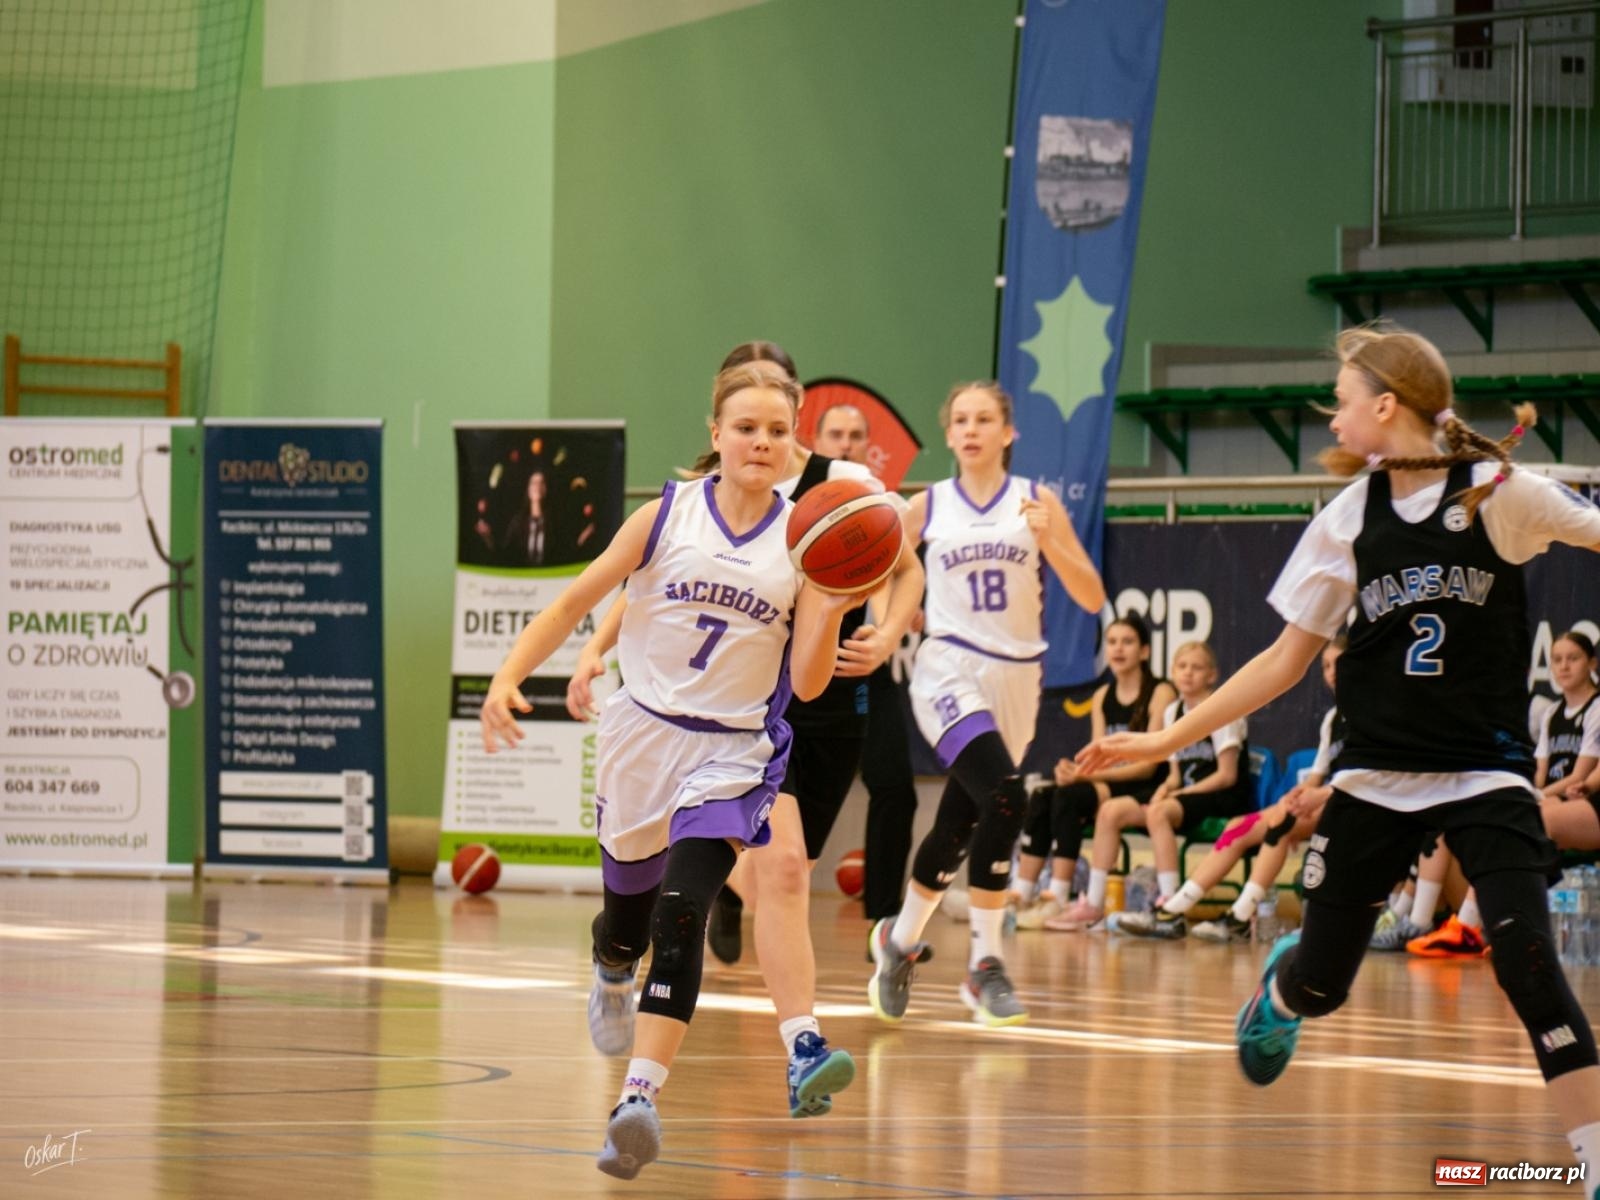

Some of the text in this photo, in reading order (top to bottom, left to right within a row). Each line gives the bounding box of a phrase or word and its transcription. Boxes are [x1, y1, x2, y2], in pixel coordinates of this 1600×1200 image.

[9, 443, 124, 466] ostromed
[9, 468, 122, 481] CENTRUM MEDYCZNE
[307, 461, 369, 483] STUDIO
[9, 522, 93, 534] DIAGNOSTYKA
[9, 545, 93, 556] PRZYCHODNIA
[940, 540, 1028, 570] RACIBÓRZ
[9, 558, 149, 570] WIELOSPECJALISTYCZNA
[24, 580, 111, 592] SPECJALIZACJI
[968, 569, 1008, 612] 18
[1360, 565, 1495, 622] WARSAW
[665, 580, 779, 625] RACIBÓRZ
[8, 611, 147, 639] PAMIĘTAJ
[688, 613, 728, 671] 7
[1404, 613, 1446, 676] 2
[8, 644, 148, 667] O ZDROWIU
[34, 688, 66, 701] LICZY
[90, 689, 120, 702] CZAS
[13, 707, 57, 719] SZYBKA
[61, 708, 122, 721] DIAGNOZA
[7, 726, 167, 739] JESTEŚMY DO DYSPOZYCJI
[5, 780, 100, 795] 604 347 669
[579, 733, 598, 830] OFERTA
[5, 832, 148, 850] www.ostromed.pl
